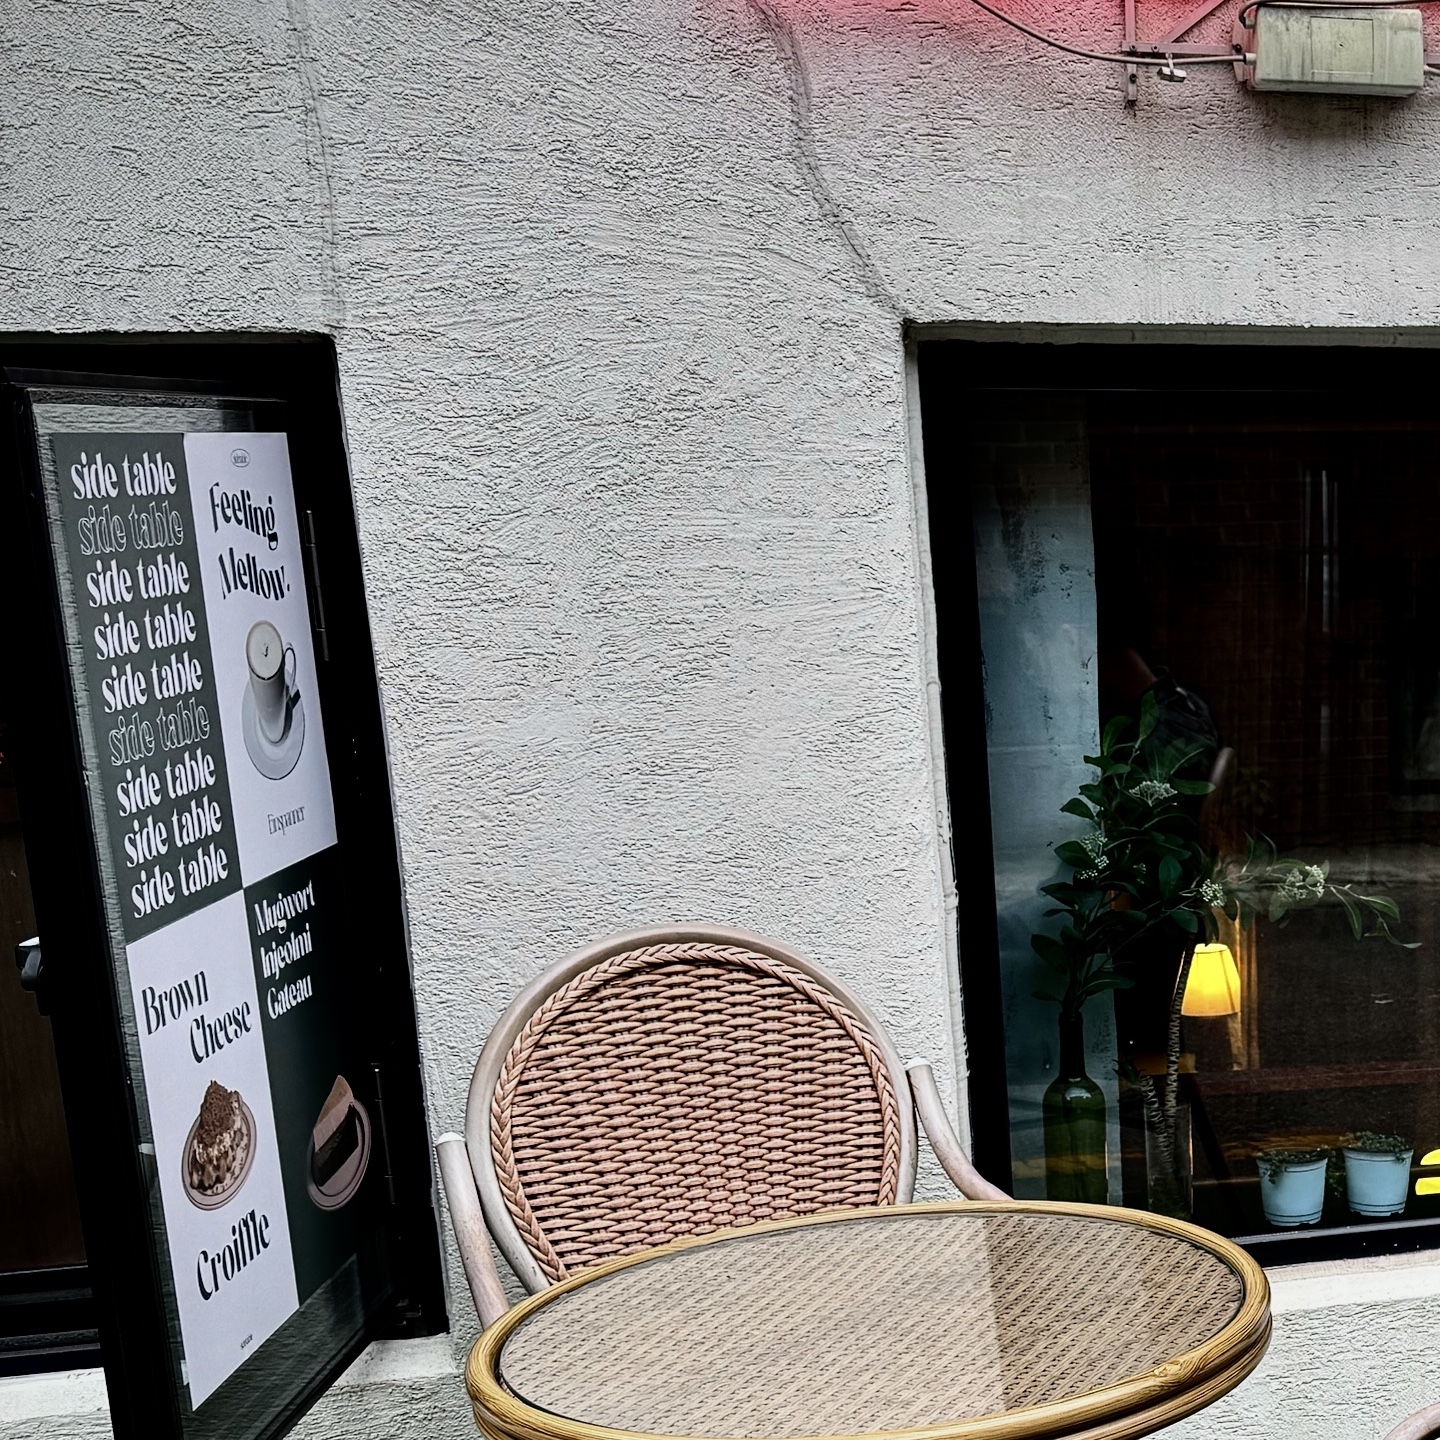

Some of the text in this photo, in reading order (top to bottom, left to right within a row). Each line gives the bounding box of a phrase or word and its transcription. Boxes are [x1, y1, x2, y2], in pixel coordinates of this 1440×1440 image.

[71, 451, 177, 500] side table
[78, 500, 184, 555] side table
[209, 481, 279, 551] Feeling
[86, 552, 190, 608] side table
[217, 546, 290, 601] Mellow.
[94, 601, 197, 661] side table
[101, 650, 203, 713] side table
[108, 696, 210, 766] side table
[116, 747, 216, 817] side table
[124, 794, 222, 868] side table
[131, 842, 229, 919] side table
[254, 879, 316, 935] Mugwort
[260, 922, 312, 980] Injeolmi
[141, 970, 209, 1036] Brown
[267, 974, 313, 1020] Gateau
[190, 1001, 252, 1064] Cheese
[196, 1208, 271, 1301] Croiffle
